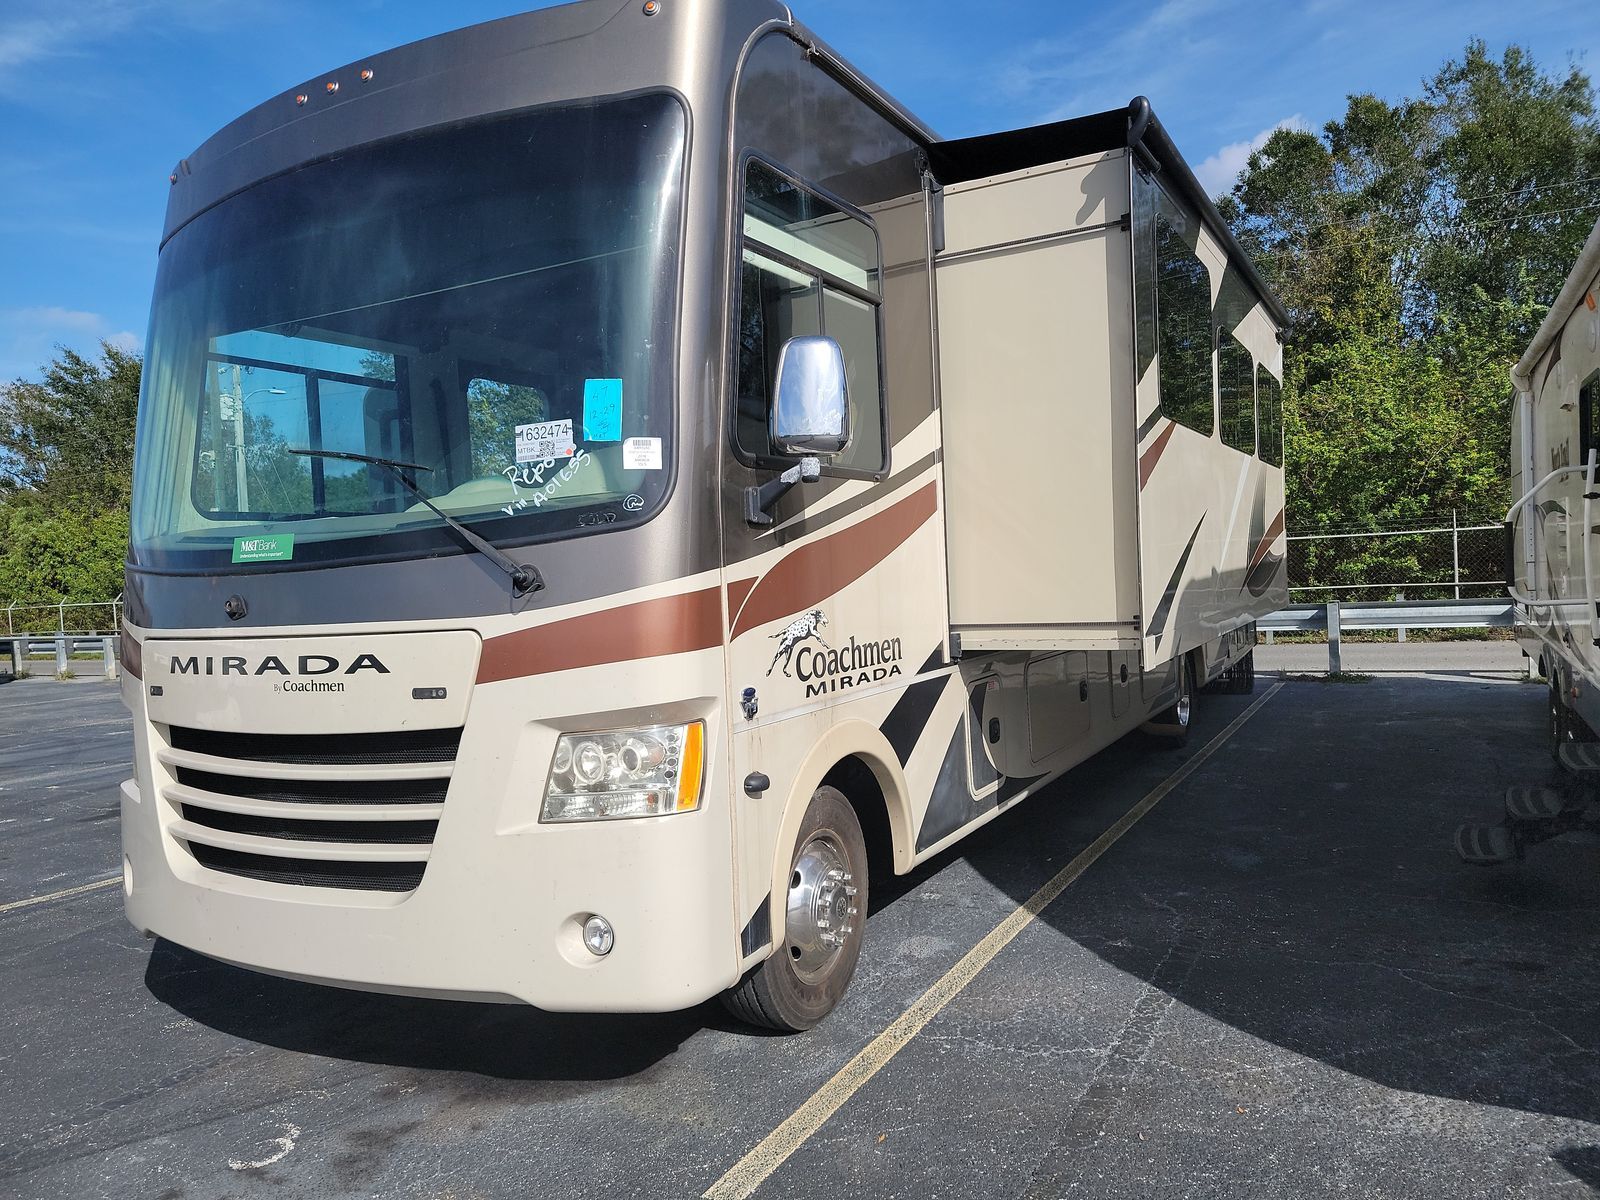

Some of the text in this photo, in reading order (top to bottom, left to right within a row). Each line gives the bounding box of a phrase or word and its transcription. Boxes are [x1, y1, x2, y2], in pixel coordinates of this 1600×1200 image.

[520, 423, 569, 442] 1632474
[502, 457, 557, 496] Repo
[240, 538, 278, 553] M&T Bank
[170, 654, 391, 675] MIRADA
[796, 635, 903, 682] Coachmen
[273, 679, 345, 694] By Coachmen
[805, 664, 902, 699] MIRADA
